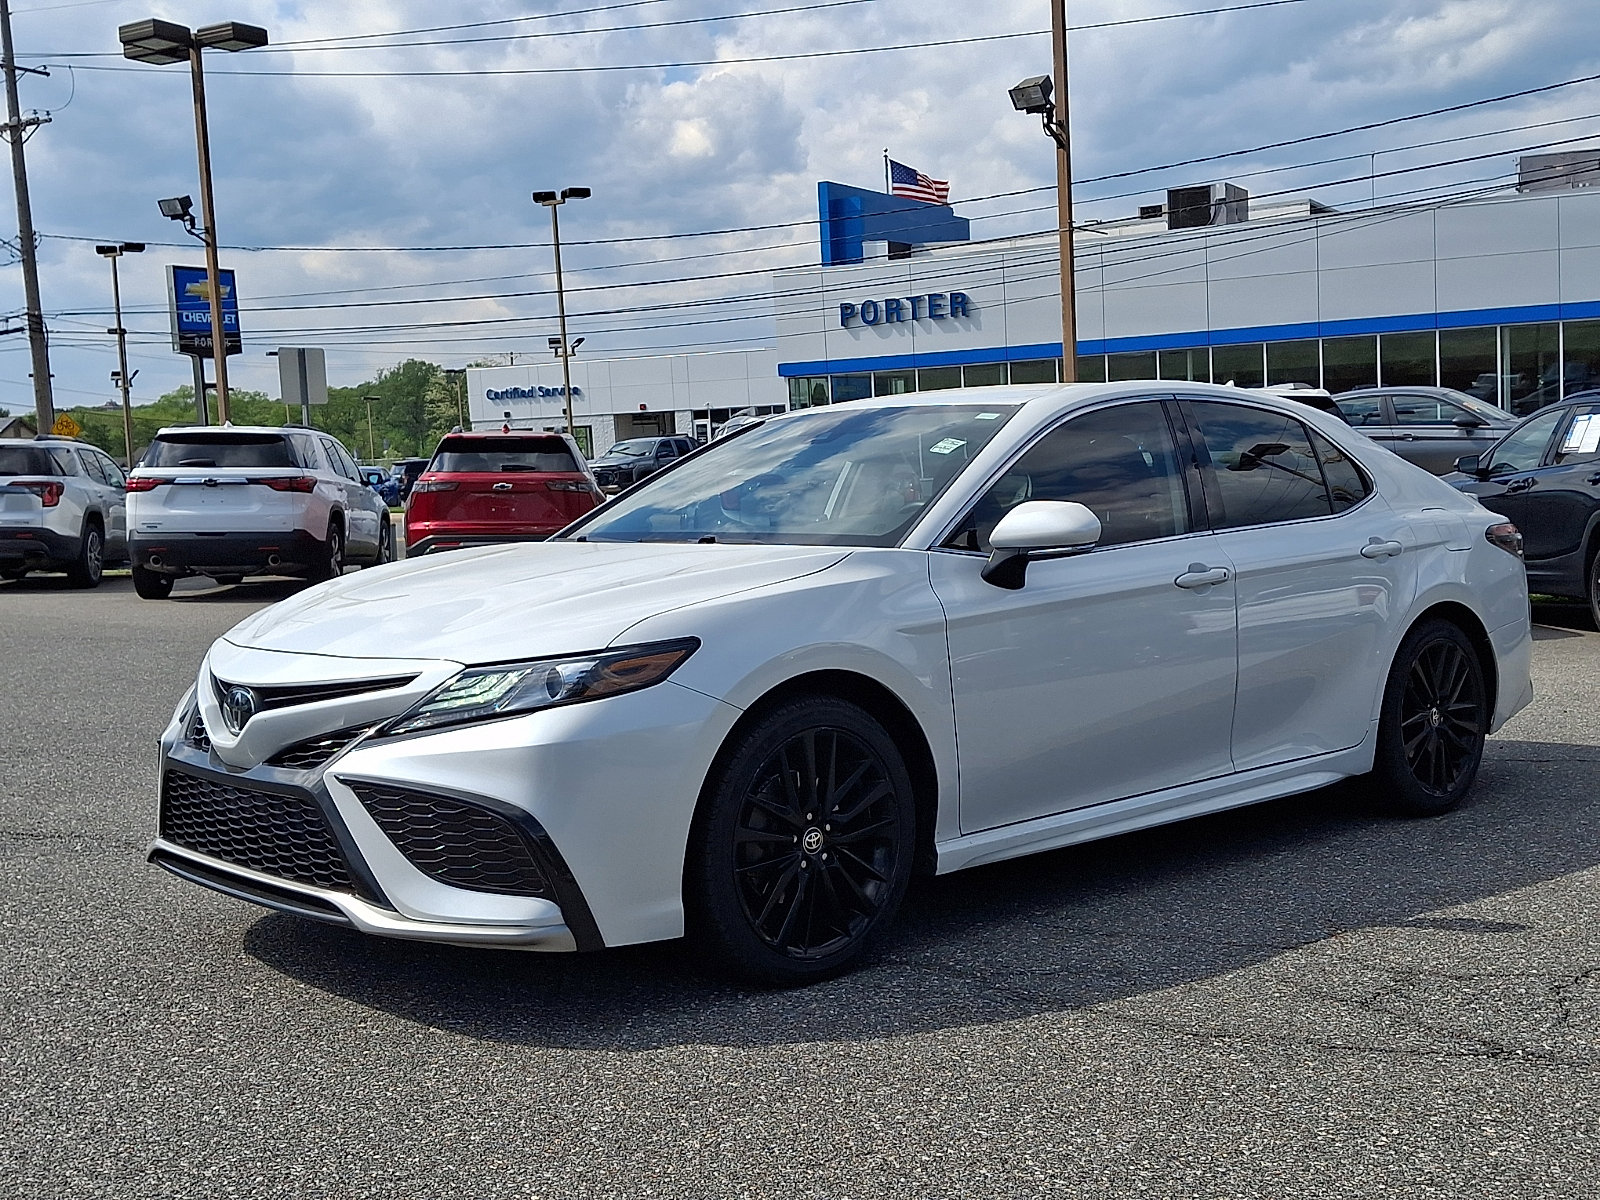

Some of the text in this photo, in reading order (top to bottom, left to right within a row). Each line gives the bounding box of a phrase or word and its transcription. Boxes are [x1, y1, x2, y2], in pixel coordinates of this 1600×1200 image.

[839, 291, 969, 327] PORTER
[182, 312, 236, 324] CHEVRET
[486, 384, 580, 400] Certified Servie
